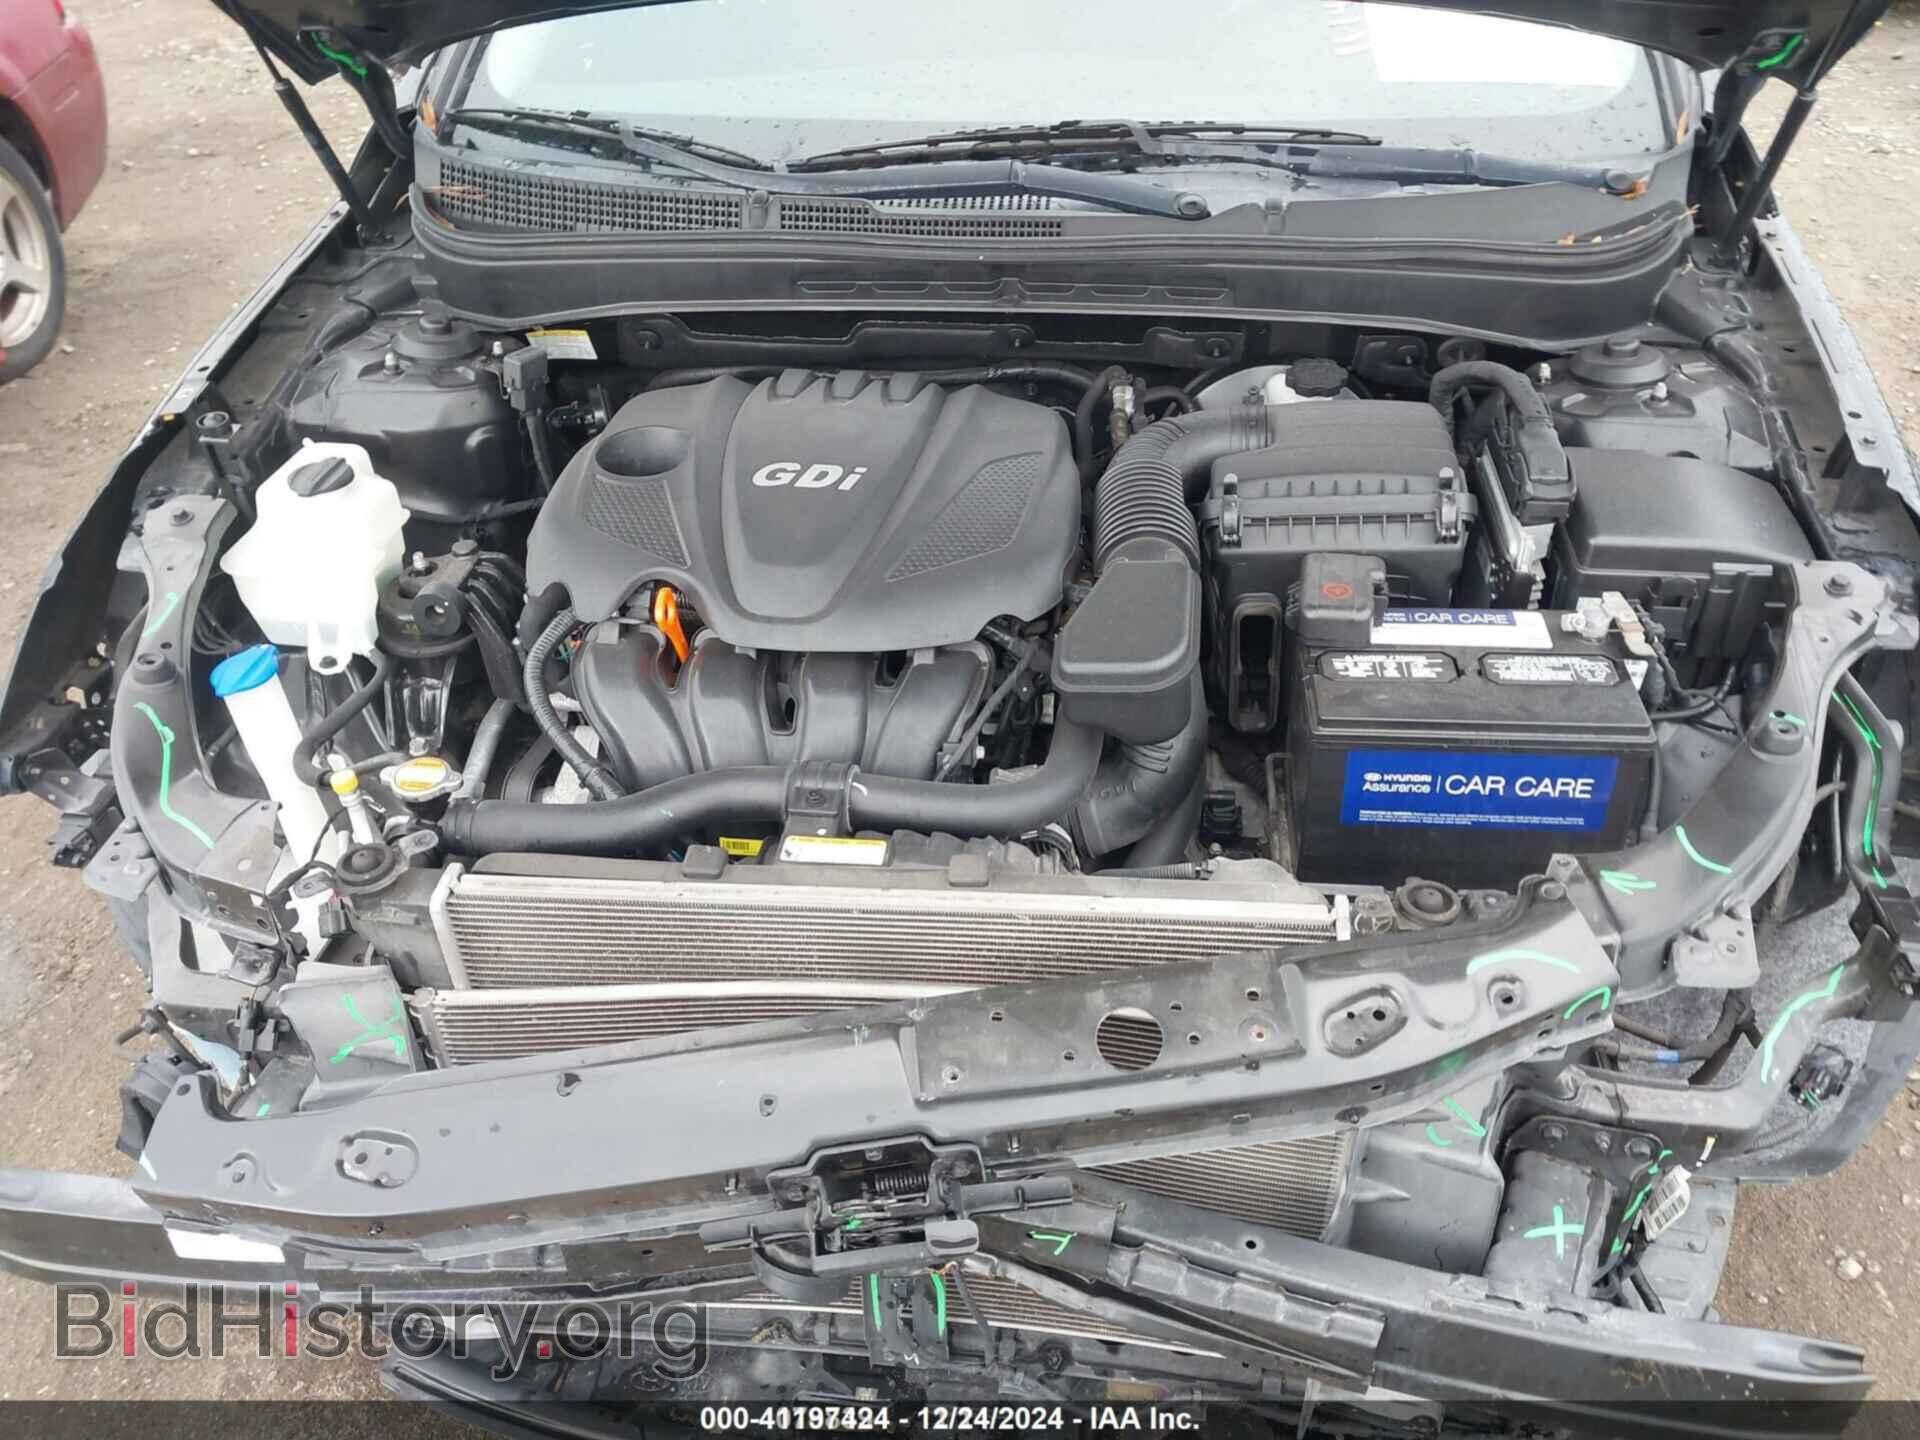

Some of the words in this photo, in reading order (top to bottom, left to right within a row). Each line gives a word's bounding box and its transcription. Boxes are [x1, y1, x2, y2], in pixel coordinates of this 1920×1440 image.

[752, 462, 868, 491] GDi
[1414, 611, 1454, 624] CAR
[1461, 612, 1509, 625] CARE
[1362, 782, 1431, 794] Assurance
[1444, 775, 1506, 796] CAR
[1514, 776, 1595, 799] CARE
